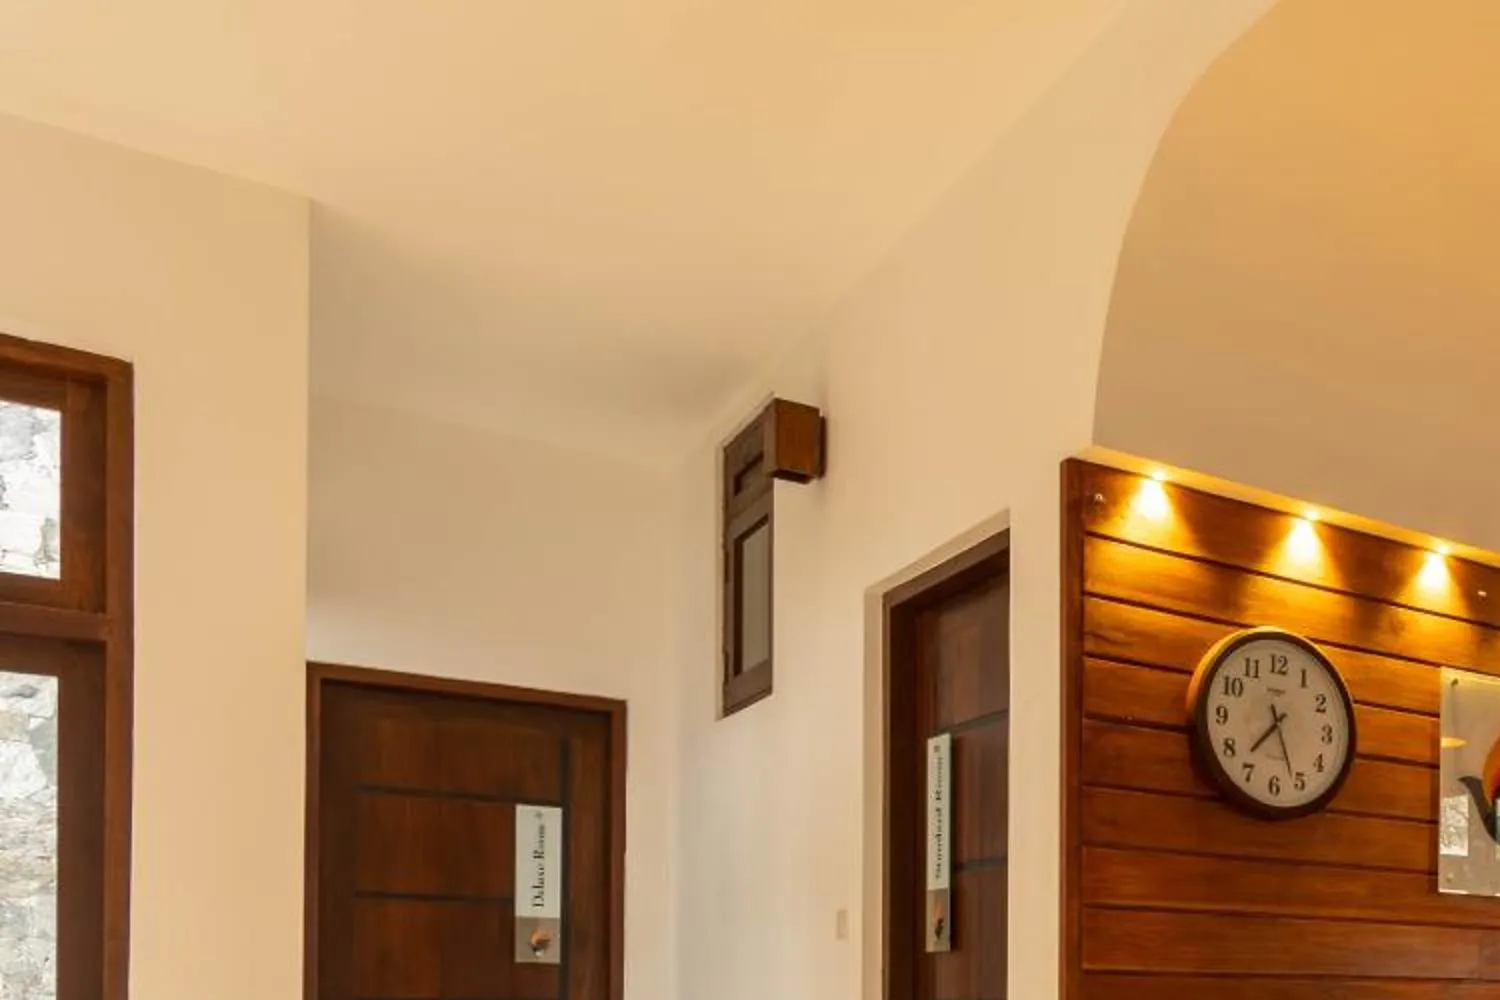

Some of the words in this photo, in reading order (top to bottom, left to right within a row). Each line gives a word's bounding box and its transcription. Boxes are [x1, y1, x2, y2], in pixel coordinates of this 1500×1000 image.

[1244, 658, 1260, 679] 11
[1269, 653, 1289, 676] 12
[1223, 675, 1244, 697] 10
[1300, 668, 1308, 688] 1
[1315, 694, 1327, 713] 2
[1216, 705, 1229, 725] 9
[1321, 725, 1333, 745] 3
[1223, 737, 1236, 758] 8
[1242, 763, 1255, 783] 7
[1313, 753, 1324, 773] 4
[1268, 775, 1280, 796] 6
[1294, 772, 1306, 791] 5
